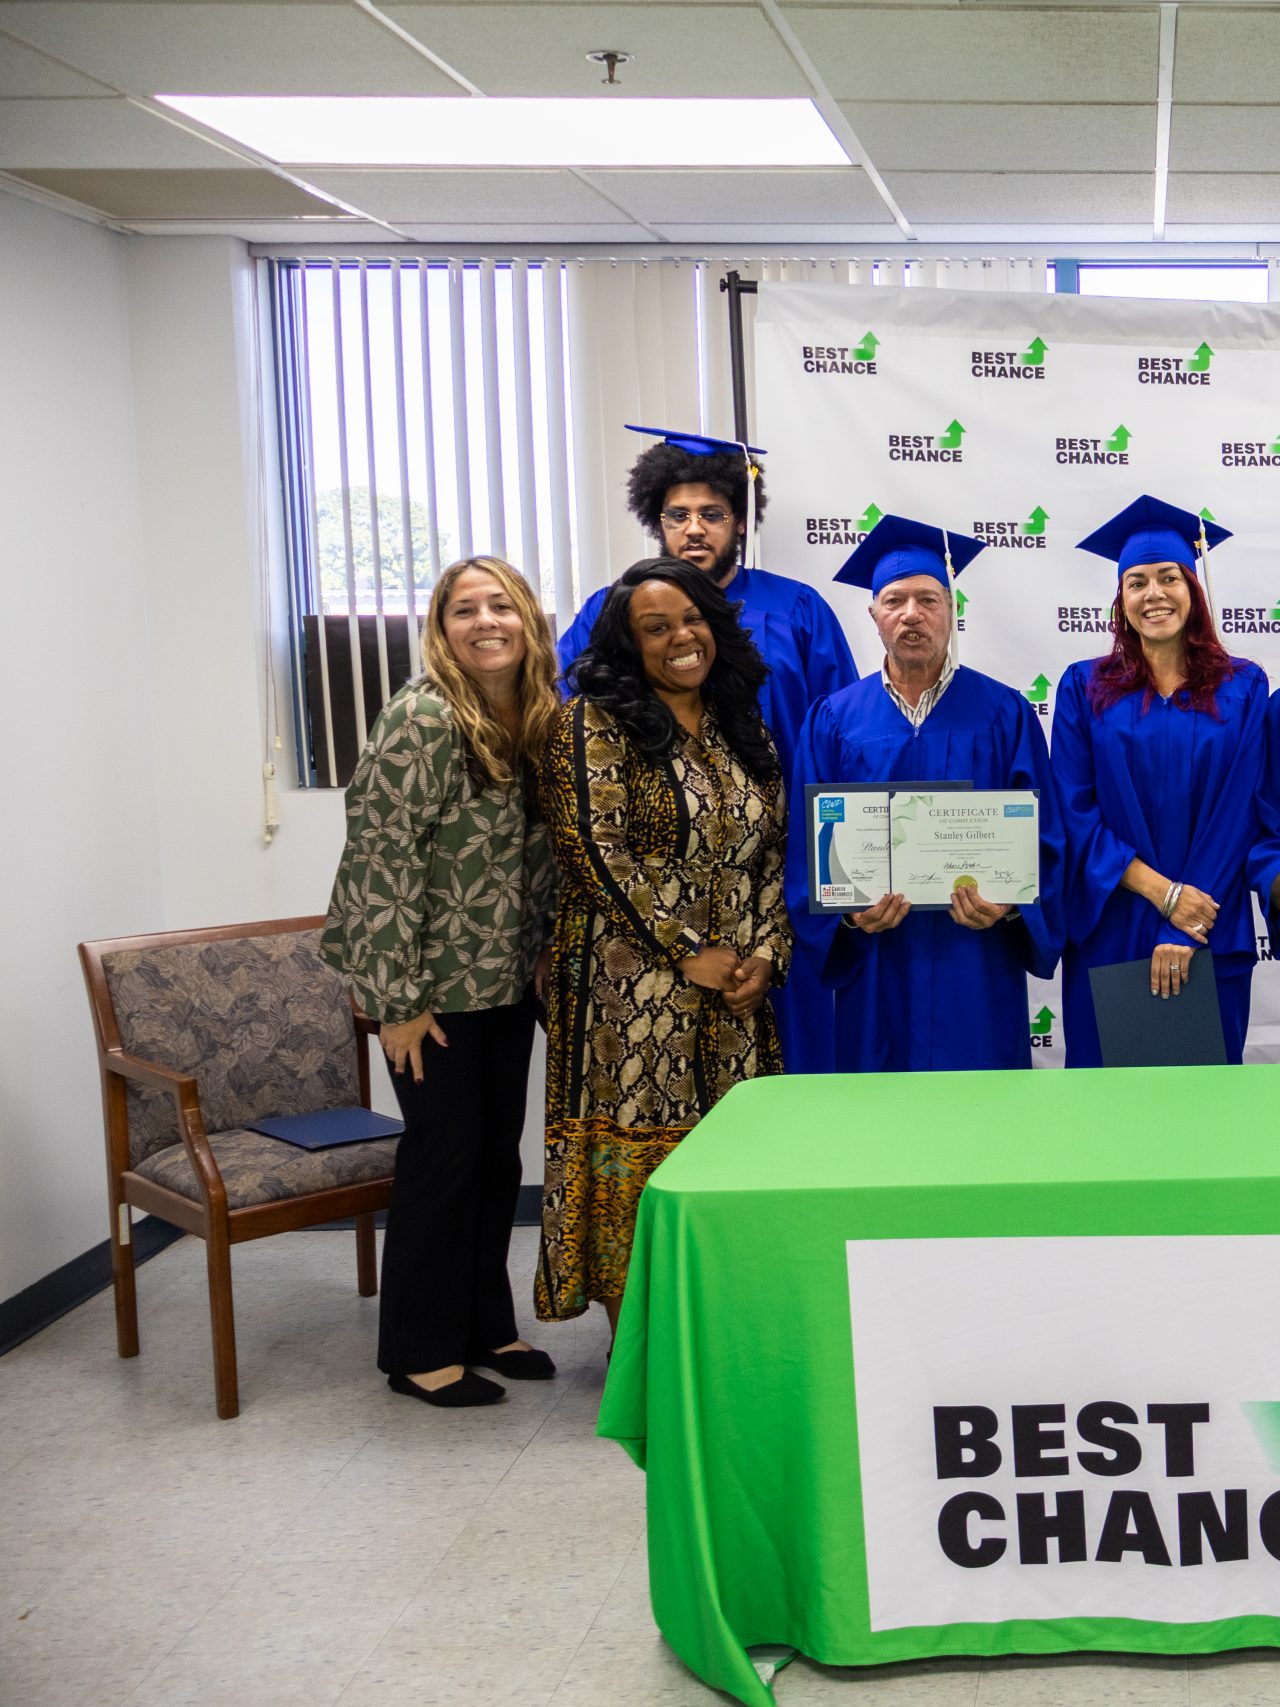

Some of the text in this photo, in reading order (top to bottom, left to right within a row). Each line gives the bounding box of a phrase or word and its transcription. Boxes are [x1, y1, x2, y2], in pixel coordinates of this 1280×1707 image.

[803, 346, 848, 360] BEST
[972, 352, 1016, 365] BEST
[803, 361, 876, 374] CHANCE
[1138, 357, 1183, 371] BEST
[972, 366, 1045, 379] CHANCE
[1138, 371, 1211, 385] CHANCE
[889, 435, 934, 448] BEST
[1056, 438, 1101, 451] BEST
[1222, 442, 1266, 454] BEST
[889, 449, 963, 462] CHANCE
[1056, 452, 1129, 464] CHANCE
[807, 519, 852, 531] BEST
[974, 522, 1018, 534] BEST
[1058, 607, 1102, 619] BEST
[1222, 608, 1266, 620] BEST
[929, 808, 998, 817] CERTIFICATE
[934, 830, 995, 841] Stanley Gilbert
[933, 1401, 1210, 1480] BEST
